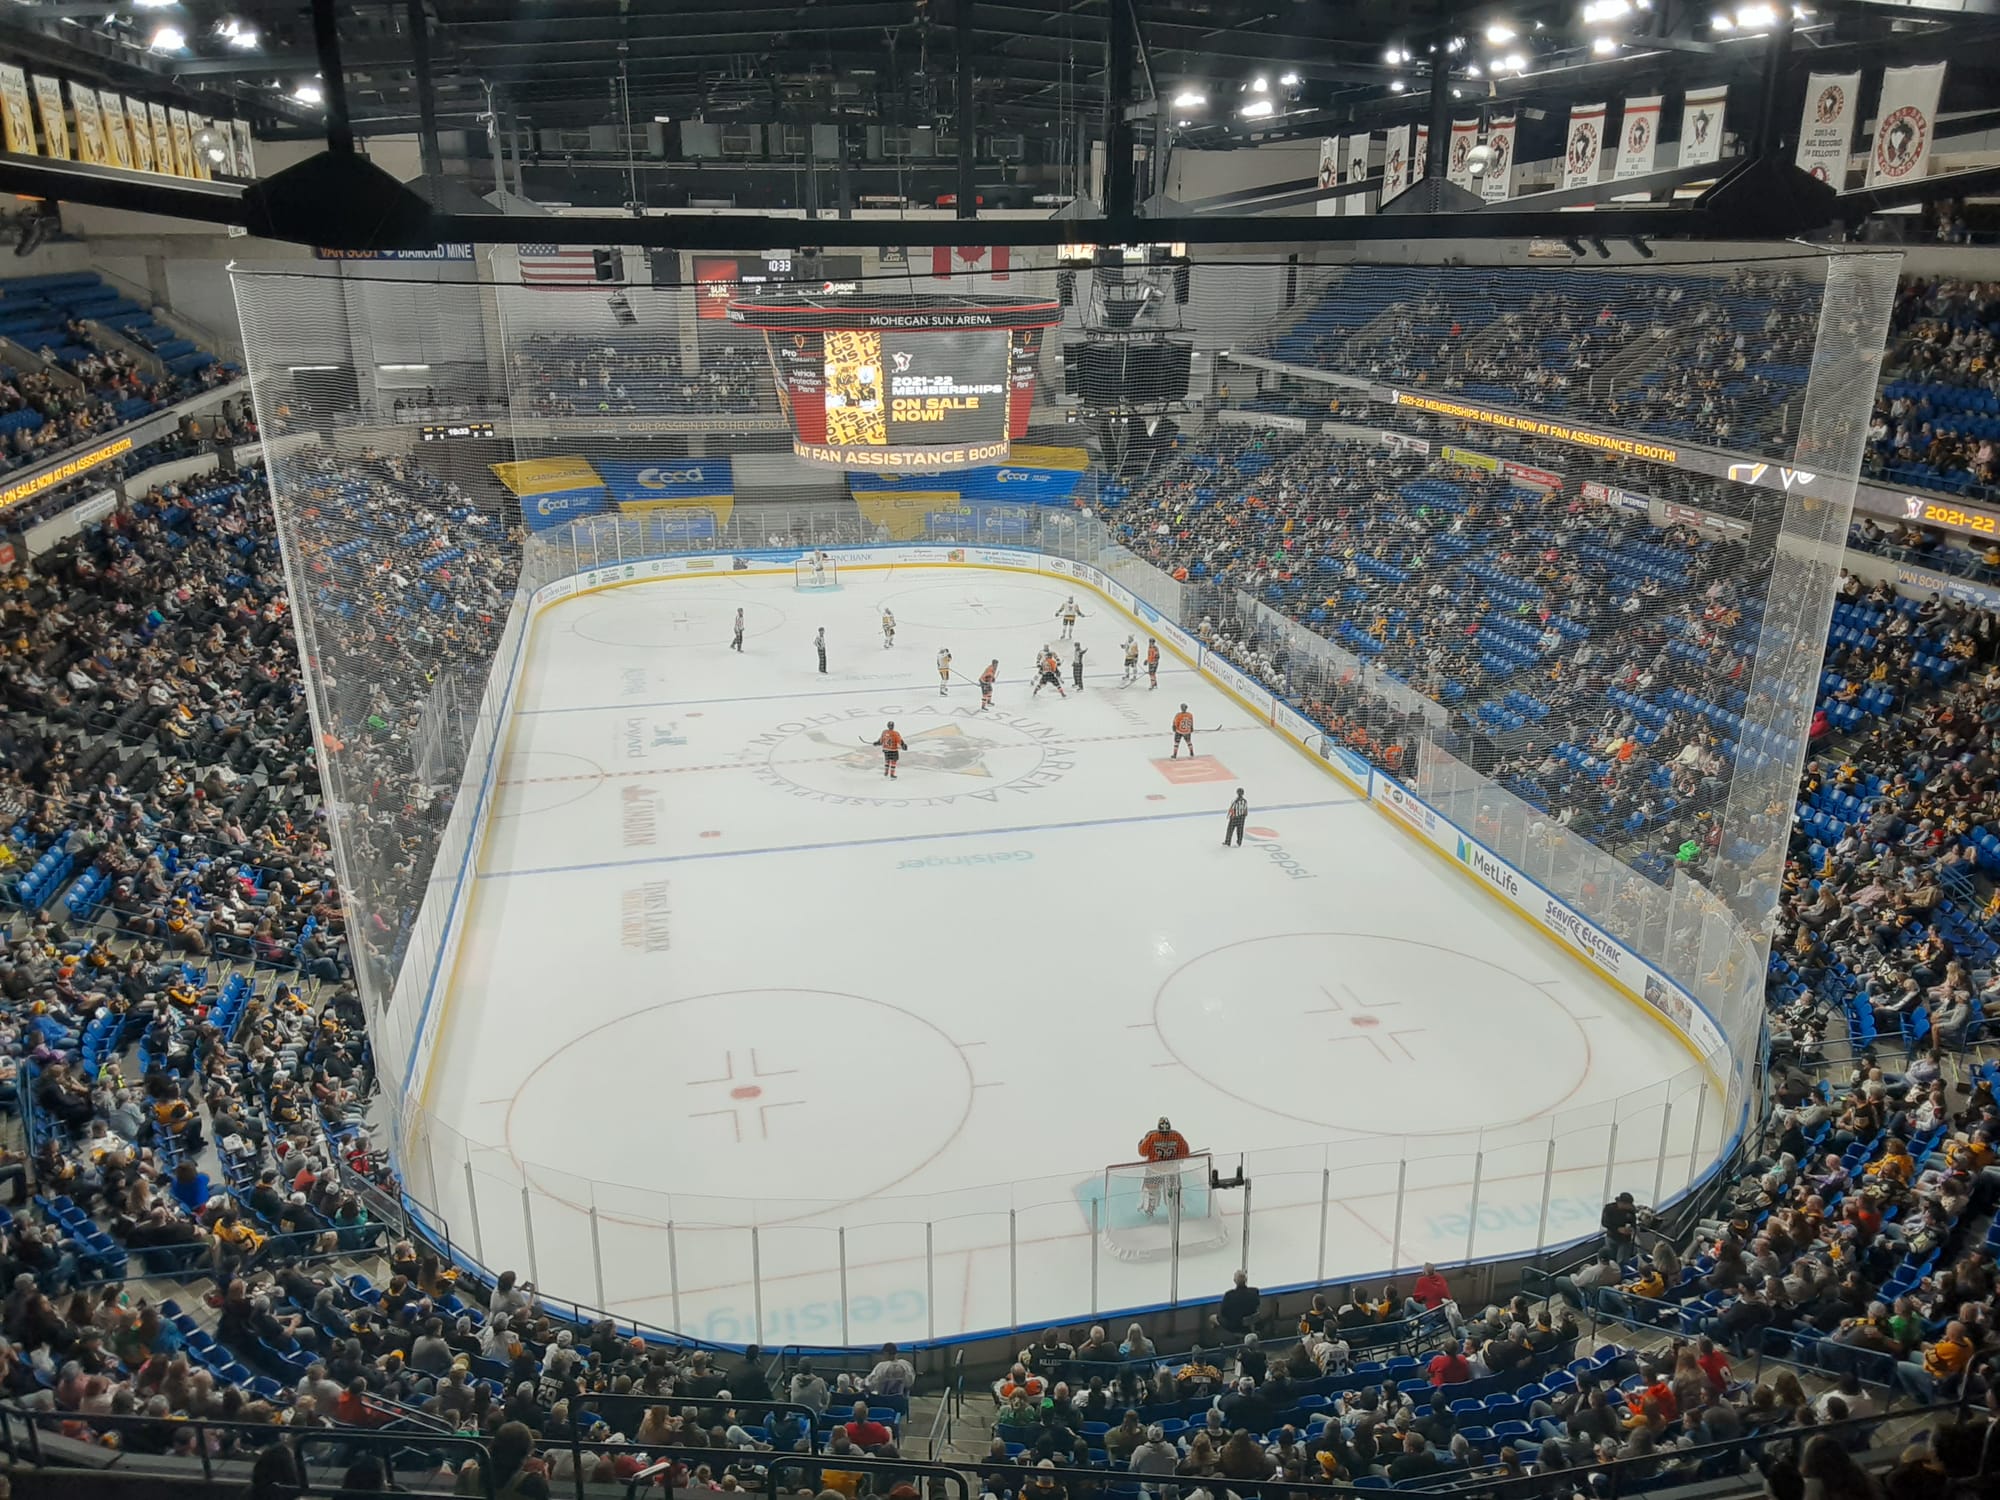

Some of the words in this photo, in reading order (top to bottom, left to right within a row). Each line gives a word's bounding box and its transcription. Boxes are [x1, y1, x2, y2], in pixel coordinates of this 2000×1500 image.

[446, 244, 473, 258] MINE
[768, 260, 791, 272] 10:33
[870, 316, 929, 326] MOHEGAN
[931, 316, 953, 326] SUN
[956, 315, 992, 325] ARENA
[789, 377, 822, 386] Protection
[792, 369, 816, 378] Vehicle
[892, 376, 953, 386] 2021-22
[892, 385, 1003, 396] MEMBERSHIPS
[892, 398, 921, 410] ON
[925, 397, 980, 409] SALE
[892, 410, 945, 422] NOW!
[629, 422, 652, 431] OUR
[656, 422, 697, 431] PASSION
[700, 422, 709, 430] IS
[712, 421, 725, 430] TO
[728, 421, 754, 430] HELP
[757, 420, 778, 429] YOU
[1399, 394, 1425, 408] 2021-22
[1425, 399, 1479, 421] MEMBERSHIPS
[1480, 412, 1493, 423] ON
[1492, 413, 1516, 428] SALE
[1516, 418, 1537, 433] NOW
[1537, 423, 1549, 434] AT
[1550, 425, 1570, 440] FAN
[1570, 429, 1633, 454] ASSISTANCE
[1634, 443, 1676, 462] BOOTH!
[799, 446, 811, 458] AT
[813, 447, 841, 463] FAN
[845, 450, 966, 465] ASSISTANCE
[4, 490, 17, 504] ON
[16, 480, 38, 498] SALE
[36, 471, 53, 490] NOW
[53, 470, 64, 485] AT
[61, 461, 77, 480] FAN
[75, 446, 113, 473] ASSISTANCE
[1925, 505, 1995, 533] 2021-22
[1898, 569, 1917, 584] VAN
[1919, 574, 1947, 591] SCOY
[1947, 581, 1975, 594] DIAMOND
[985, 712, 1064, 740] SUN
[967, 746, 1077, 803] ARENA
[896, 849, 1034, 870] Geisinger
[1253, 843, 1318, 880] pepsi
[1473, 850, 1519, 897] MetLife
